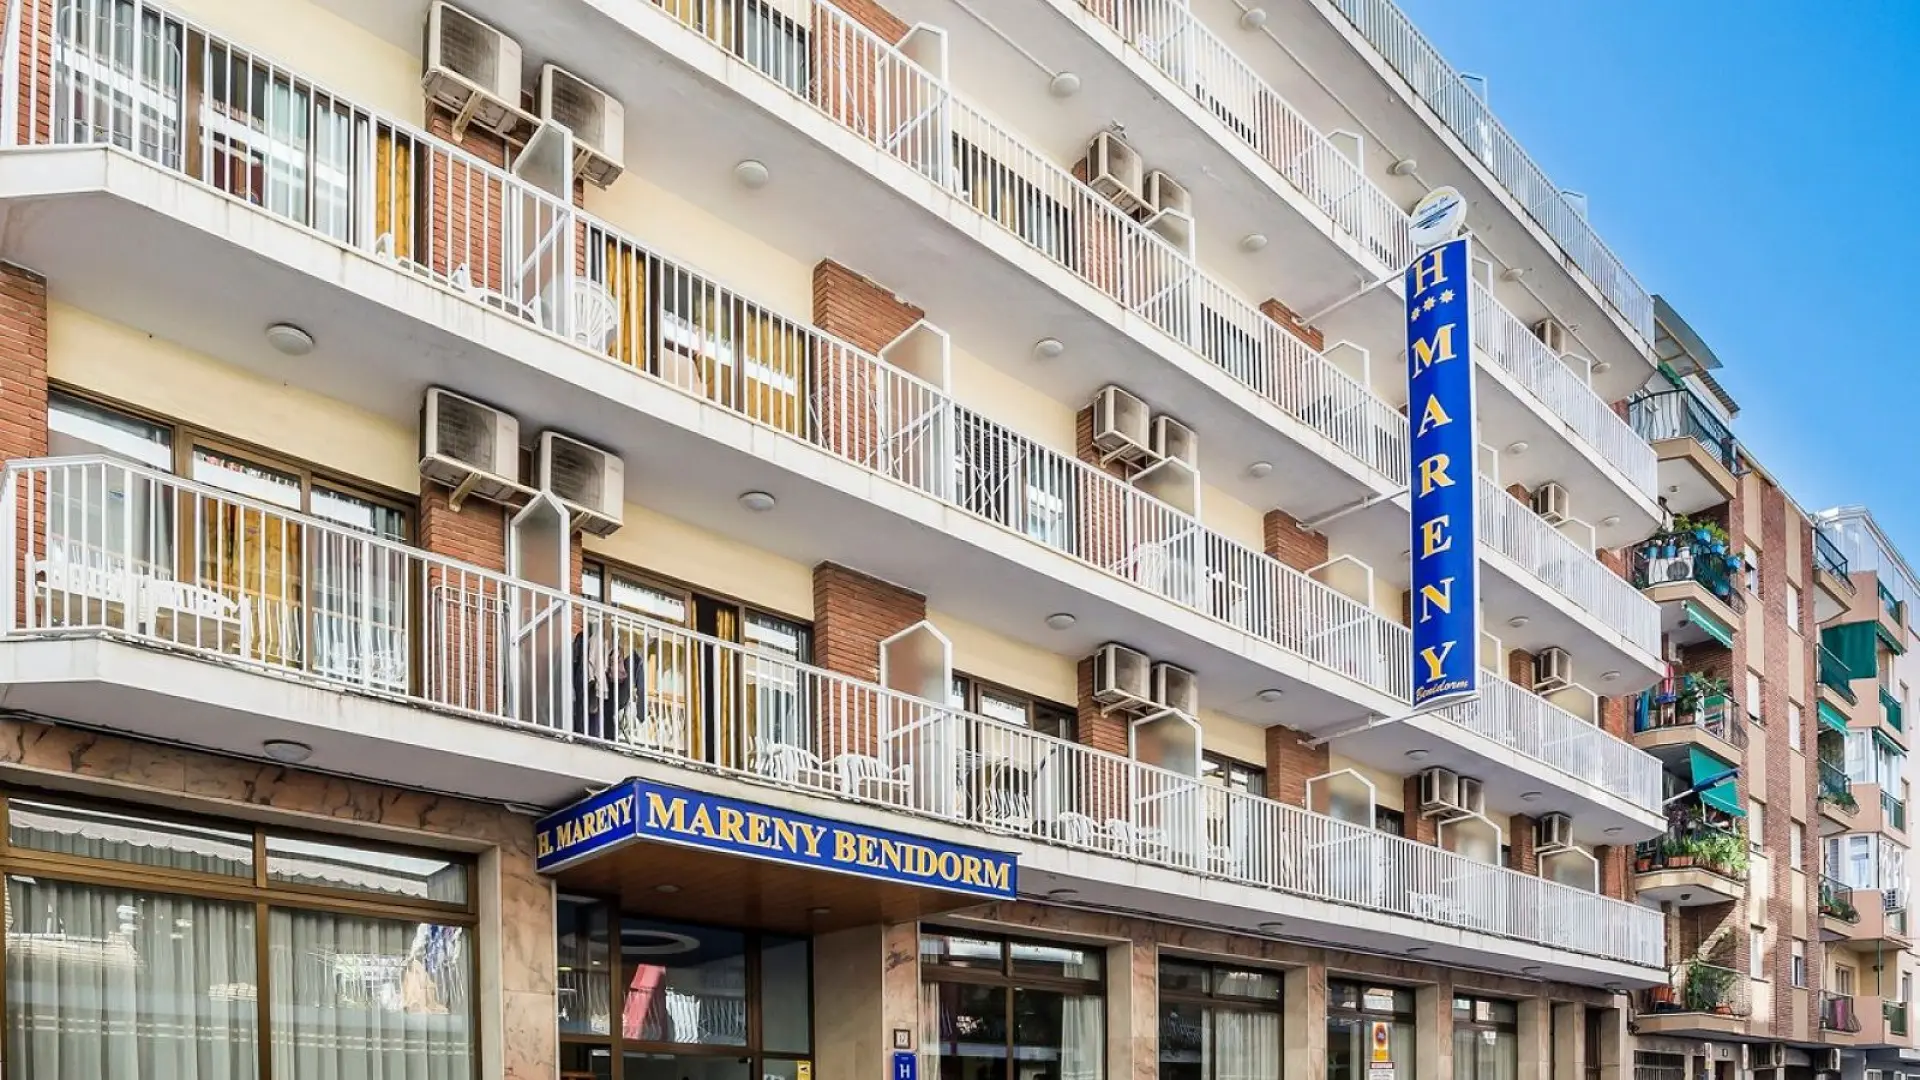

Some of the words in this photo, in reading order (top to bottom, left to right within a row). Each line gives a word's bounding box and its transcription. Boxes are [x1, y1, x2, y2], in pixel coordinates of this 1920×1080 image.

[1412, 246, 1449, 299] H
[1411, 322, 1458, 683] MARENY
[1415, 679, 1469, 700] Benidorm
[537, 830, 554, 859] H.
[556, 794, 635, 852] MARENY
[645, 791, 827, 858] MARENY
[832, 829, 1012, 892] BENIDORM
[900, 1063, 911, 1079] H
